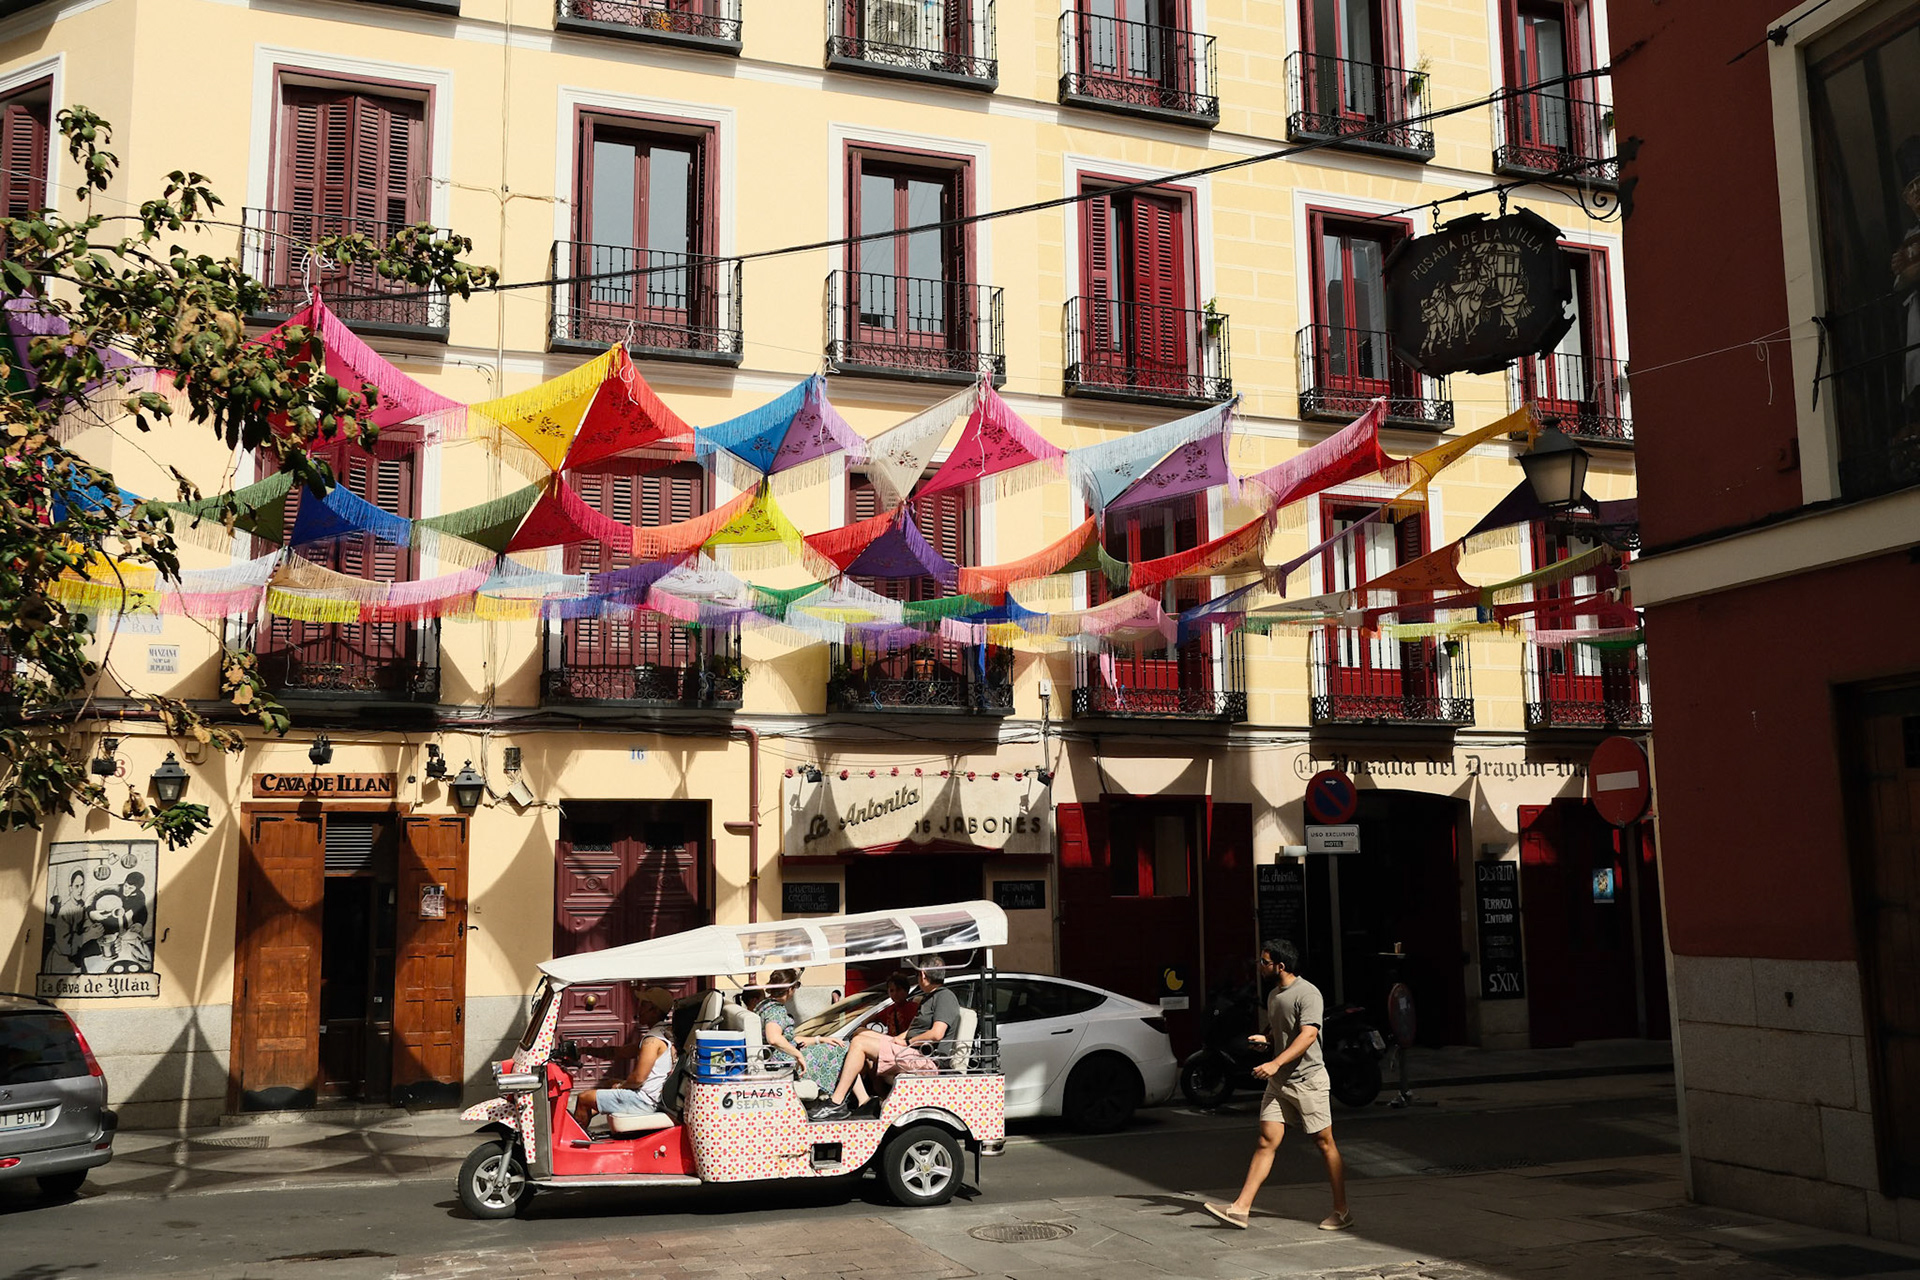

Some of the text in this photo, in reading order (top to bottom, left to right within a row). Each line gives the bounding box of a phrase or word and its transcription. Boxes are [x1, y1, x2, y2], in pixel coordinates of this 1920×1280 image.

[1410, 226, 1543, 280] POSADA DE LA VILLA
[132, 621, 161, 633] BAJA
[149, 648, 177, 657] MANZANA
[631, 749, 645, 761] 16
[1298, 759, 1314, 774] 14
[1330, 753, 1416, 776] Posada
[1425, 755, 1457, 776] del
[260, 773, 391, 792] CAVA DE ILLAN
[804, 784, 920, 844] La Antonita
[914, 816, 1042, 835] 16 JABONES
[1483, 898, 1513, 910] TERRAZA
[41, 980, 53, 993] La
[56, 978, 80, 994] Cava
[84, 978, 103, 993] de
[722, 1087, 783, 1109] 6 PLAZAS
[736, 1099, 774, 1110] SEATS
[17, 1110, 42, 1124] BYM
